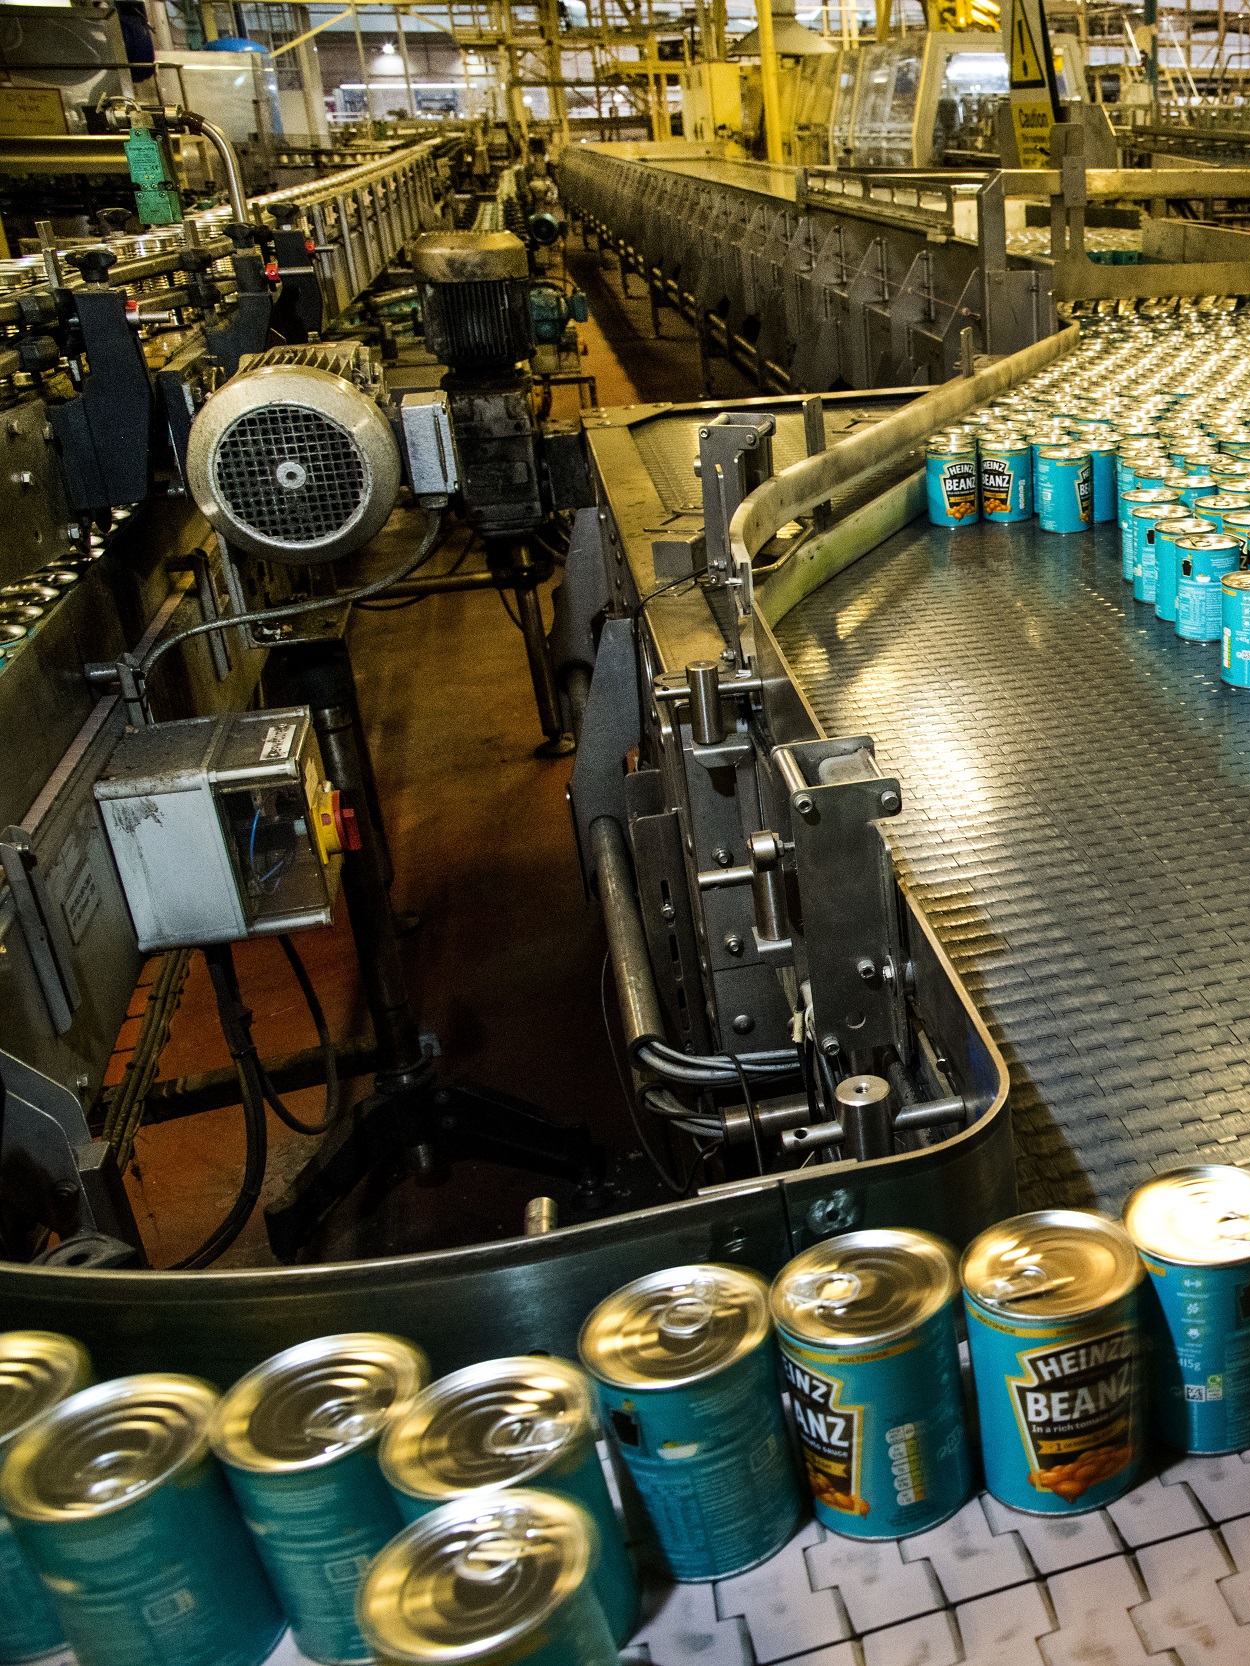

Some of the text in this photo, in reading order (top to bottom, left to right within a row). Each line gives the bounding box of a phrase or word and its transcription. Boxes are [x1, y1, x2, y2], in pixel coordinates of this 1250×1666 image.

[949, 463, 974, 476] HEINZ
[945, 477, 976, 491] BEANZ
[1037, 1338, 1121, 1381] HEINZ
[1025, 1362, 1132, 1423] BEANZ
[793, 1398, 850, 1448] ANZ
[1031, 1424, 1044, 1434] In
[1053, 1422, 1074, 1433] rich
